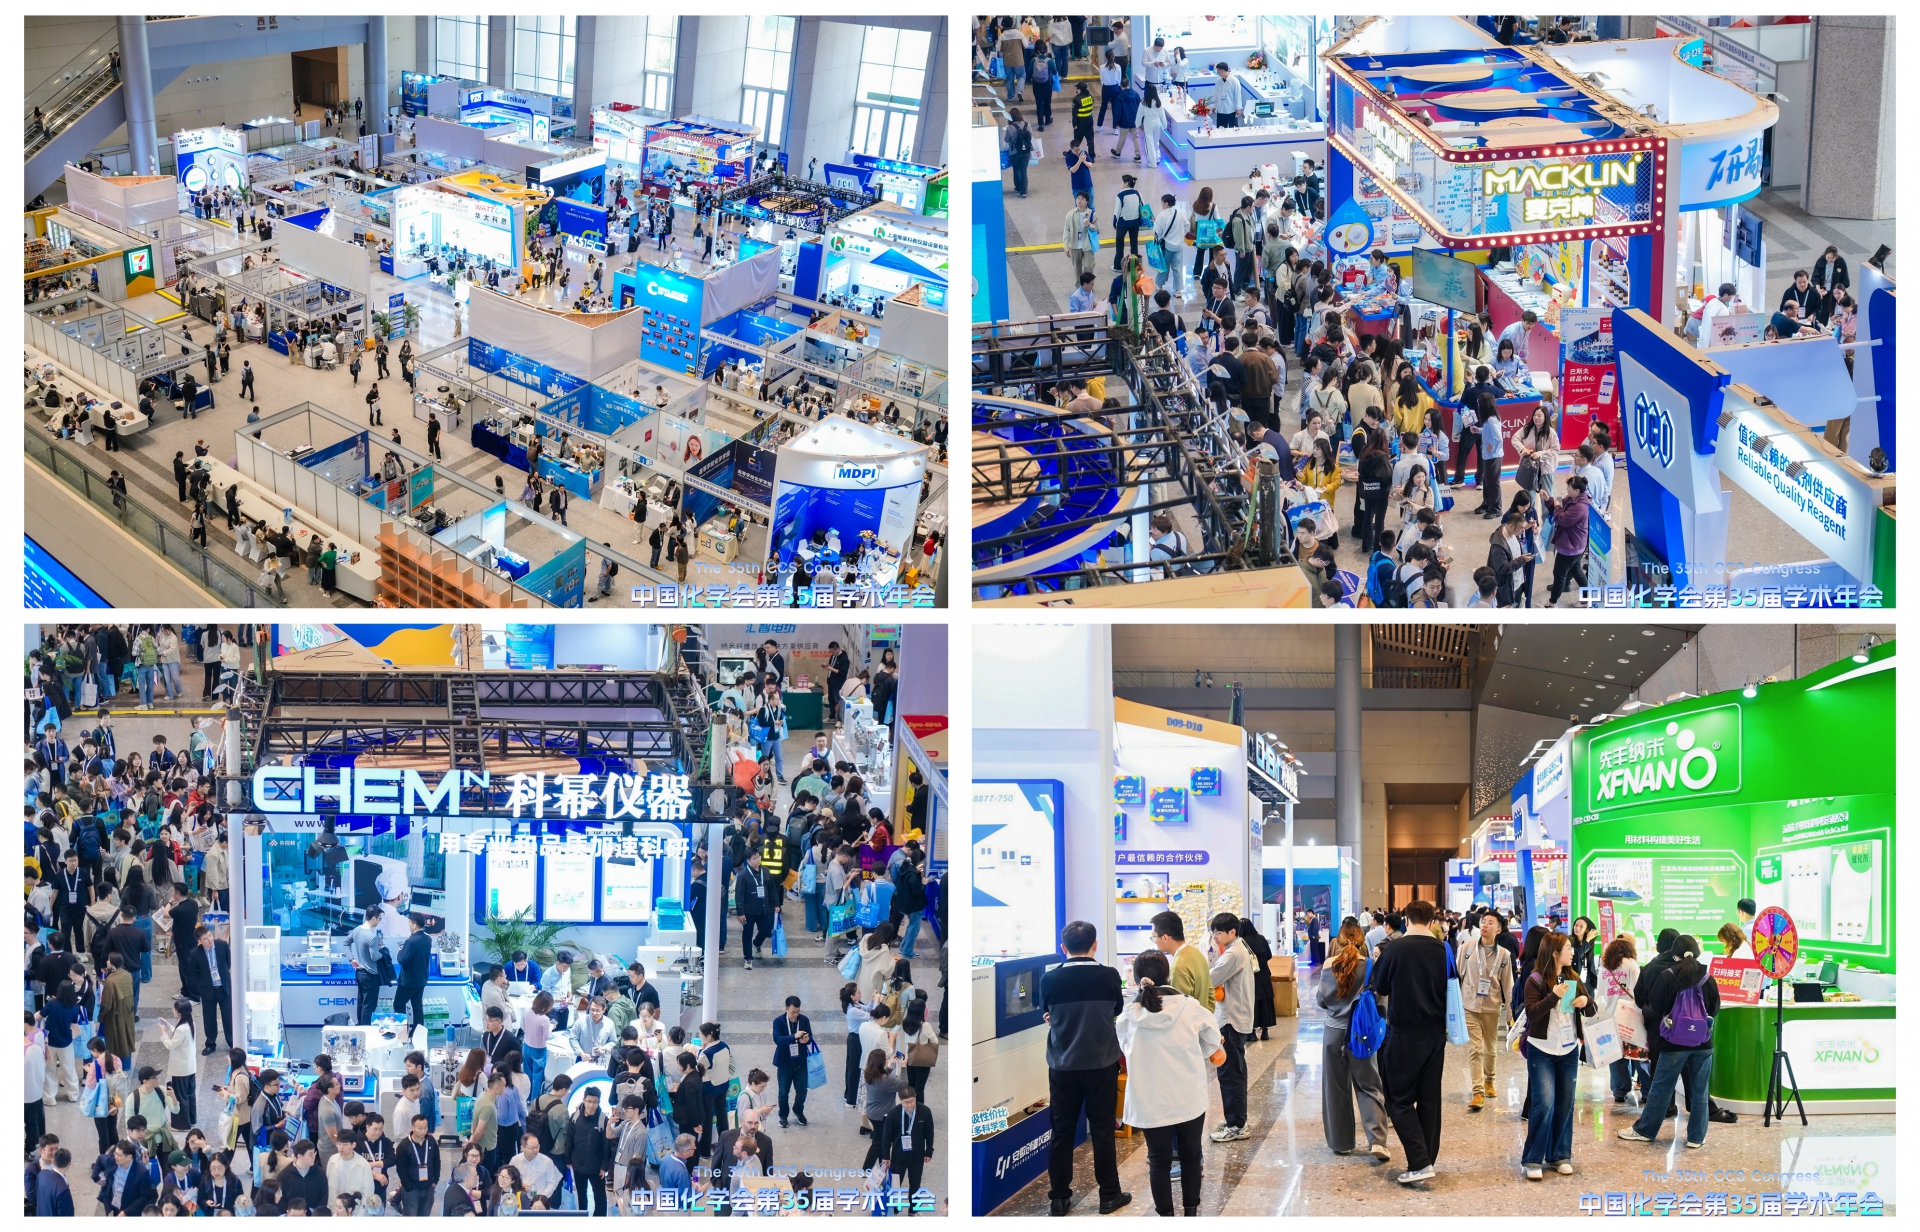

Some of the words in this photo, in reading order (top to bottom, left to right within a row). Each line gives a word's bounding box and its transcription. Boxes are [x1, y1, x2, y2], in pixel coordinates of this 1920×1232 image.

[1484, 160, 1637, 196] MACKLIN
[475, 212, 507, 226] 华太科思
[838, 468, 876, 479] MDPI
[1738, 446, 1772, 484] Reliable
[1773, 473, 1806, 513] Quality
[1807, 498, 1847, 541] Reagent
[1166, 717, 1203, 732] D09-D10
[1599, 737, 1665, 770] 先丰纳米
[1597, 747, 1717, 801] XFNANO
[505, 771, 693, 822] 科幂仪器
[438, 832, 690, 861] 用专业和品质加速科研
[1624, 835, 1701, 845] 用材料构建美好生活
[1713, 967, 1742, 978] 扫码抽奖
[1816, 1040, 1857, 1048] 先丰纳米
[1814, 1047, 1880, 1063] XFNANO
